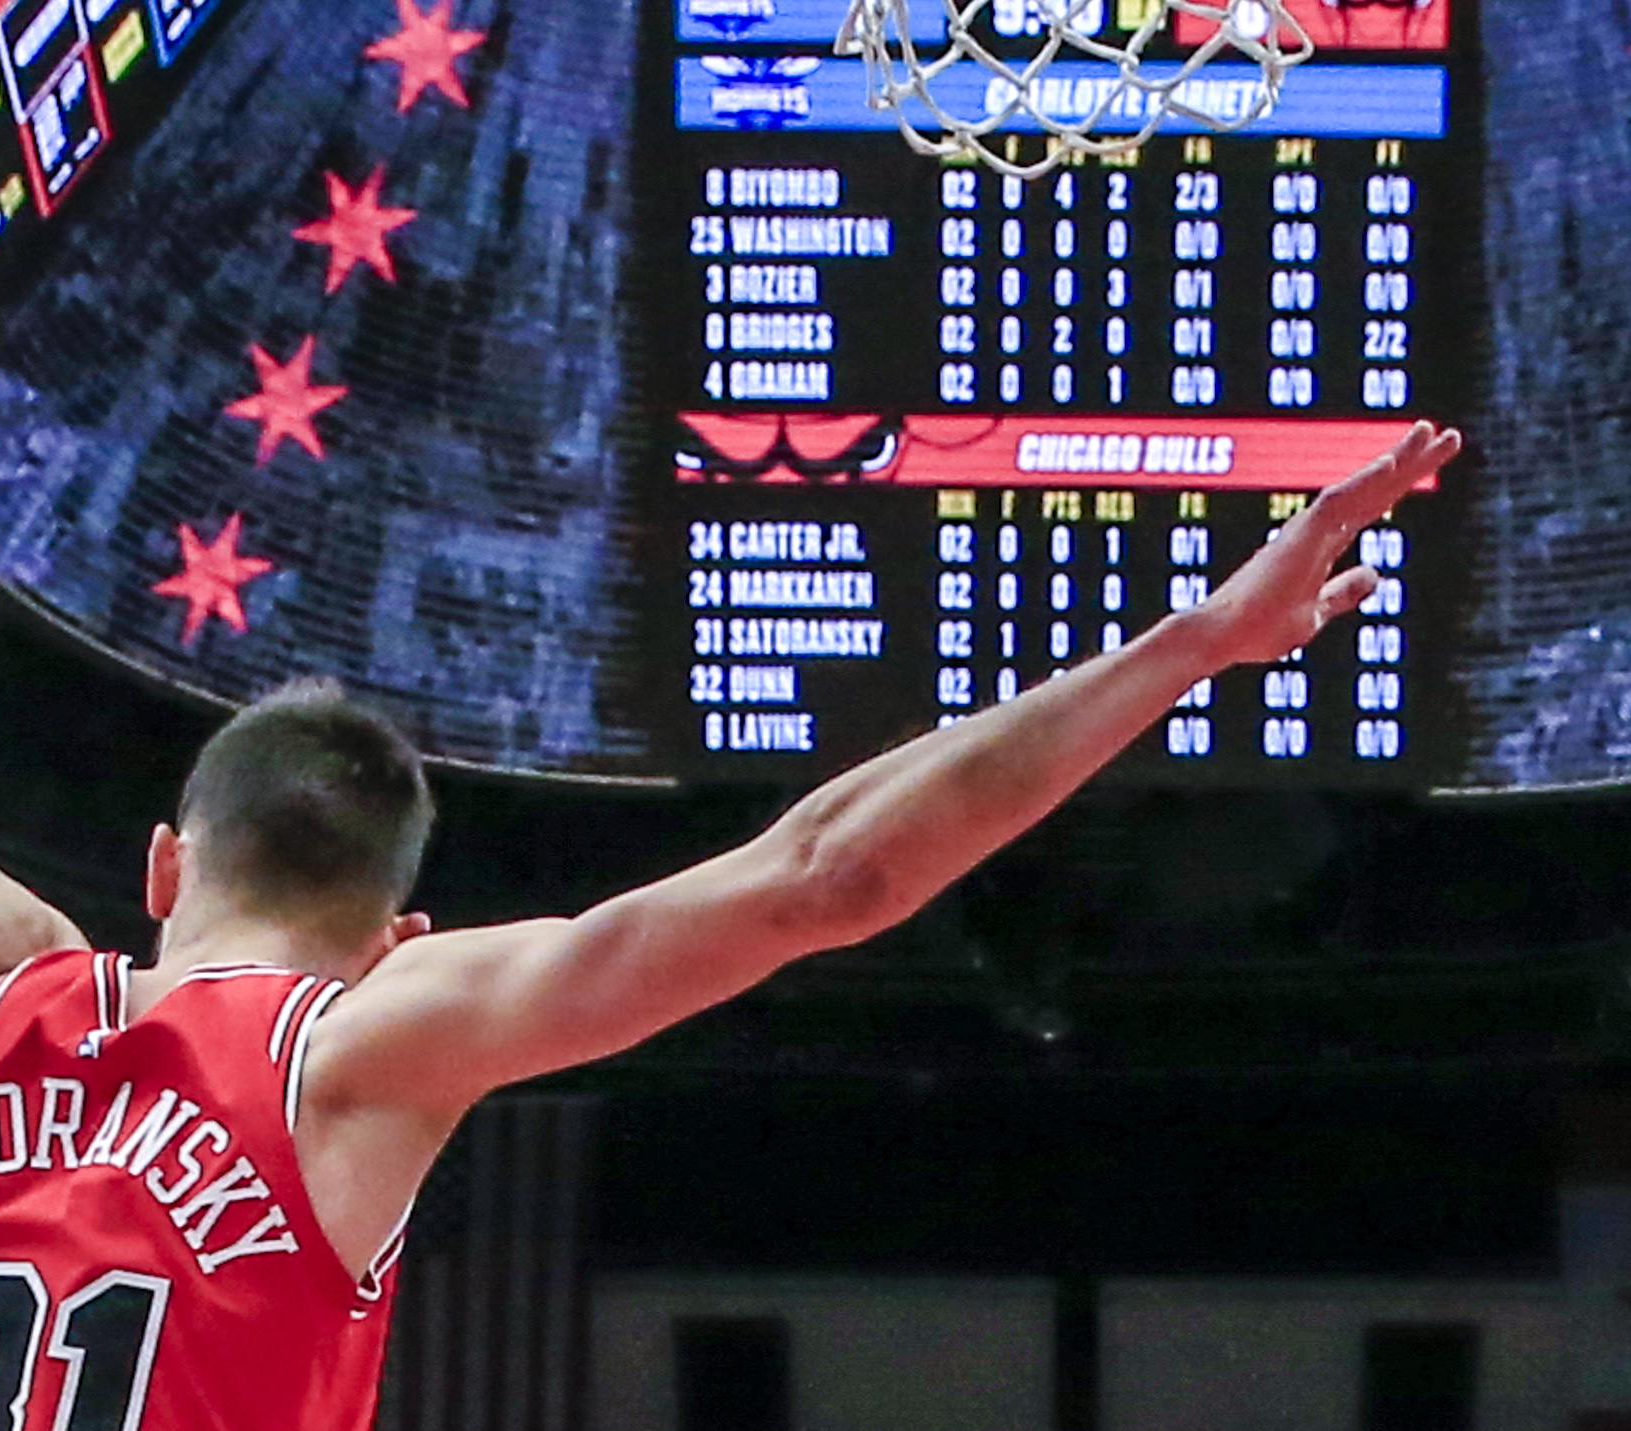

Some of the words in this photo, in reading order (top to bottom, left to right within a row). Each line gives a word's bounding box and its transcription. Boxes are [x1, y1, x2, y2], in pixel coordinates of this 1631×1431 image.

[1054, 171, 1074, 210] 4
[1107, 172, 1128, 210] 2
[690, 215, 724, 254] 25
[729, 215, 890, 255] WASHINGTON
[1107, 268, 1125, 307] 3
[1053, 315, 1074, 353] 2
[704, 361, 723, 399] 4
[1107, 364, 1122, 404] 1
[1017, 434, 1142, 472] CHICAGO
[1142, 435, 1234, 473] BULLS
[690, 522, 723, 560] 34
[729, 522, 822, 561] CARTER
[825, 523, 866, 561] JR.
[939, 524, 972, 563] 02
[1106, 526, 1120, 565] 1
[689, 570, 723, 608] 24
[729, 571, 872, 608] MARKKANEN
[938, 572, 972, 610] 02
[695, 618, 723, 655] 31
[729, 619, 883, 656] SATORANSKY
[938, 620, 972, 658] 02
[1000, 622, 1014, 657] 1
[690, 664, 723, 701] 32
[938, 667, 971, 705] 02
[729, 712, 813, 750] LAVINE
